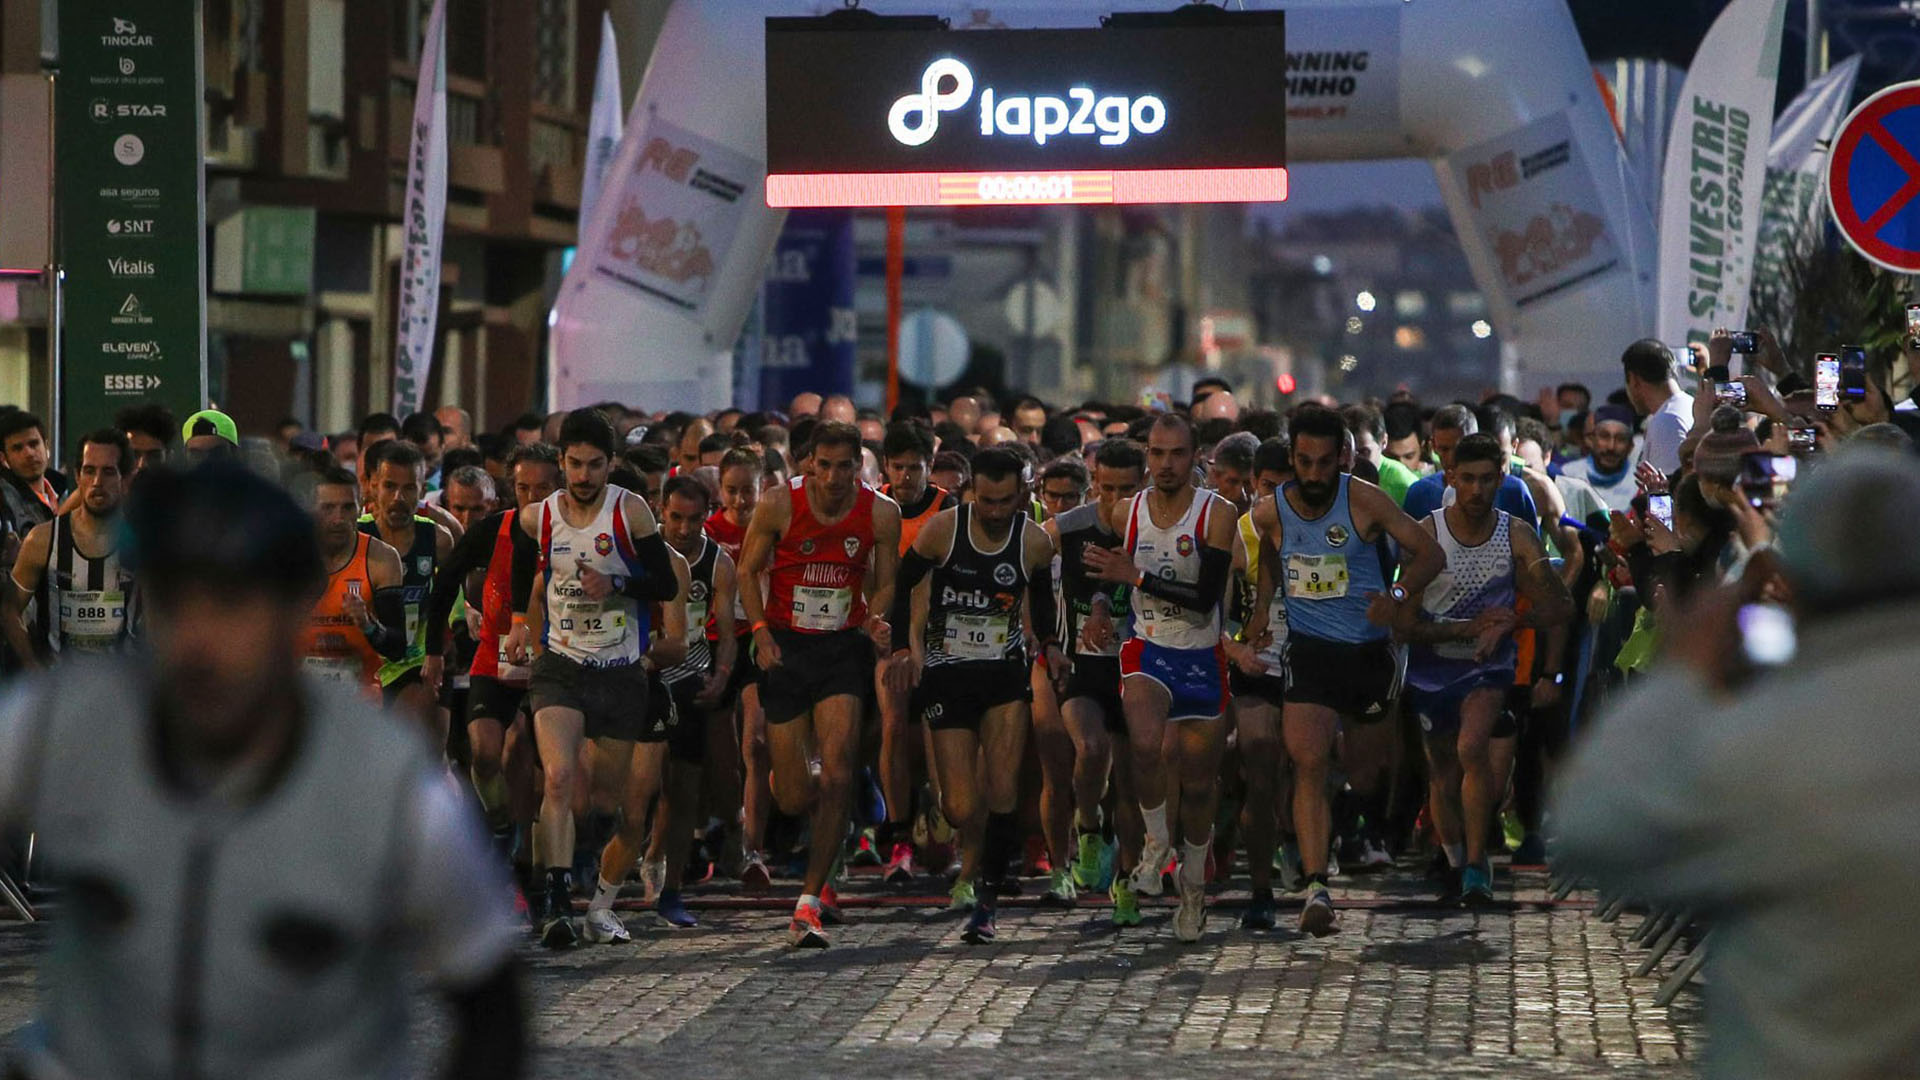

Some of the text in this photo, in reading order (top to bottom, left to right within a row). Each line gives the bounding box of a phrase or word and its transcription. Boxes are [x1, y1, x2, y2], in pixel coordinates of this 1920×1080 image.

[101, 35, 154, 46] TINOCAR
[117, 104, 167, 116] STAR
[979, 86, 1167, 146] lap2go
[978, 175, 1073, 200] 00:00:01
[99, 188, 160, 199] asa seguros
[124, 220, 154, 233] SNT
[107, 257, 155, 274] Vitalis
[104, 375, 144, 389] ESSE
[1311, 572, 1319, 583] 9
[78, 607, 105, 618] 888
[820, 604, 829, 613] 4
[1162, 605, 1182, 617] 20
[584, 619, 602, 630] 12
[968, 631, 985, 642] 10
